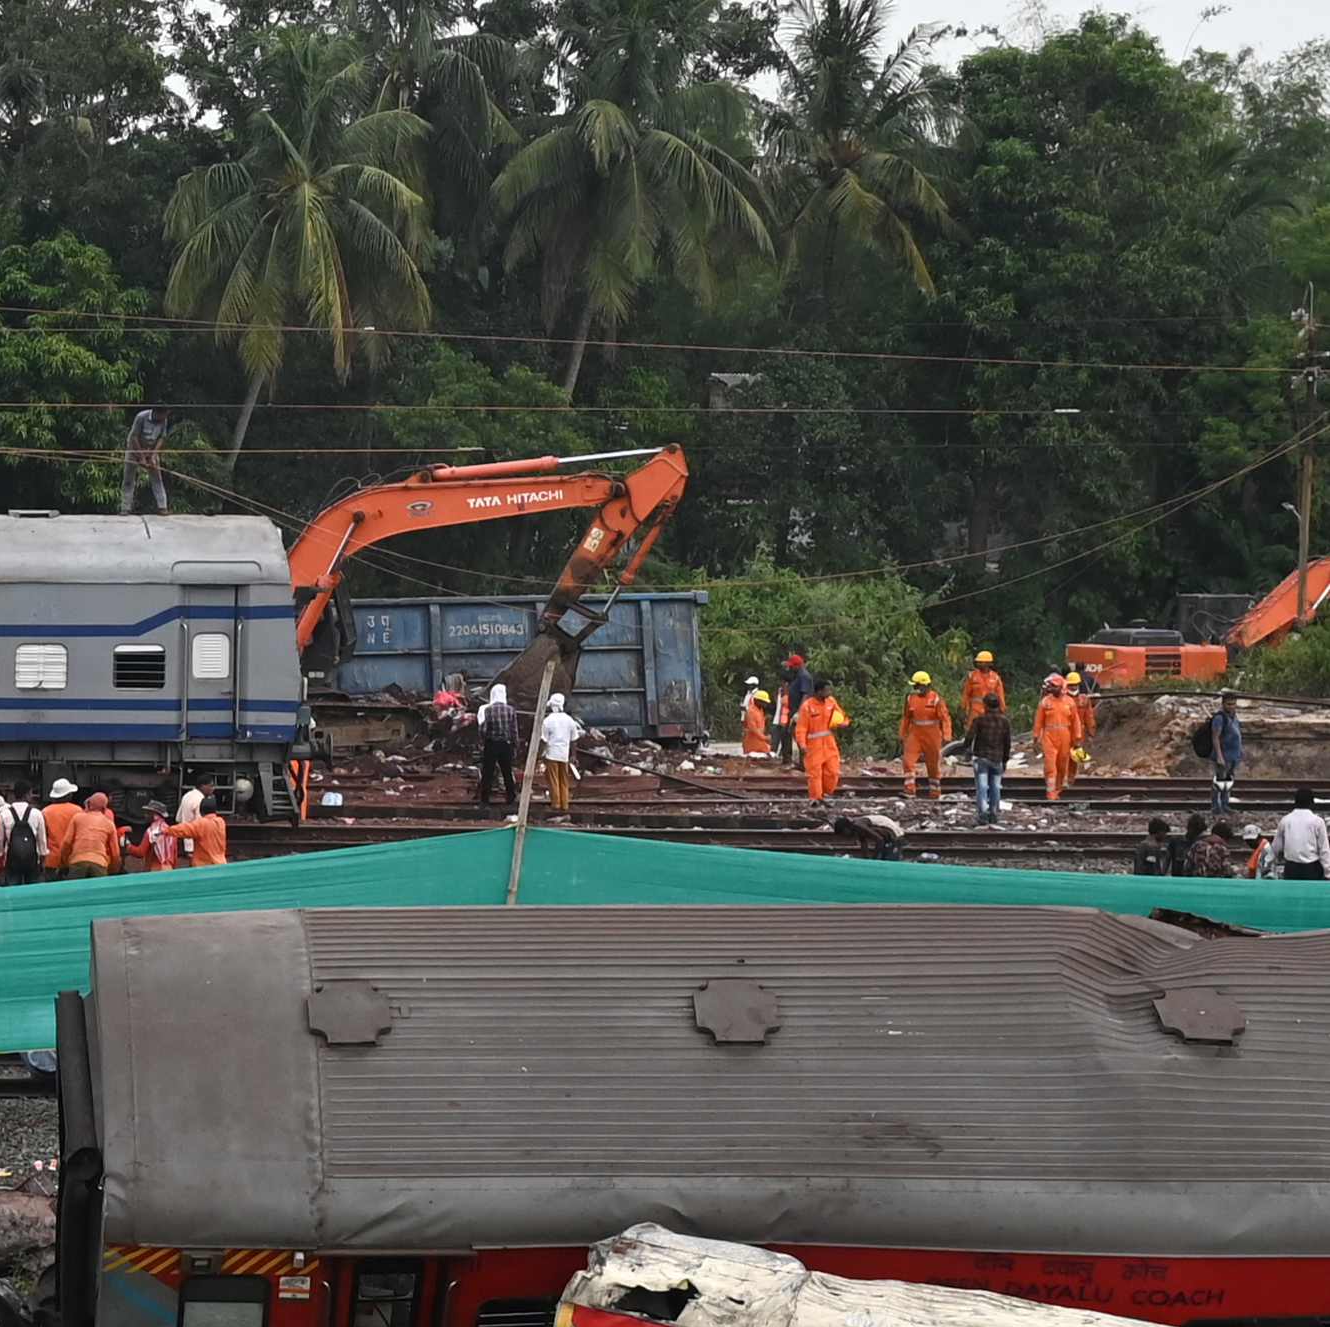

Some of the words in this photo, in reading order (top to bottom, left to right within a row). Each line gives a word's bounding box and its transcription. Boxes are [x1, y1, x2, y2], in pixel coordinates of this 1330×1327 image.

[466, 495, 502, 510] TATA
[506, 489, 565, 505] HITACHI
[1004, 1281, 1115, 1304] DAYALU
[1131, 1289, 1225, 1306] COACH
